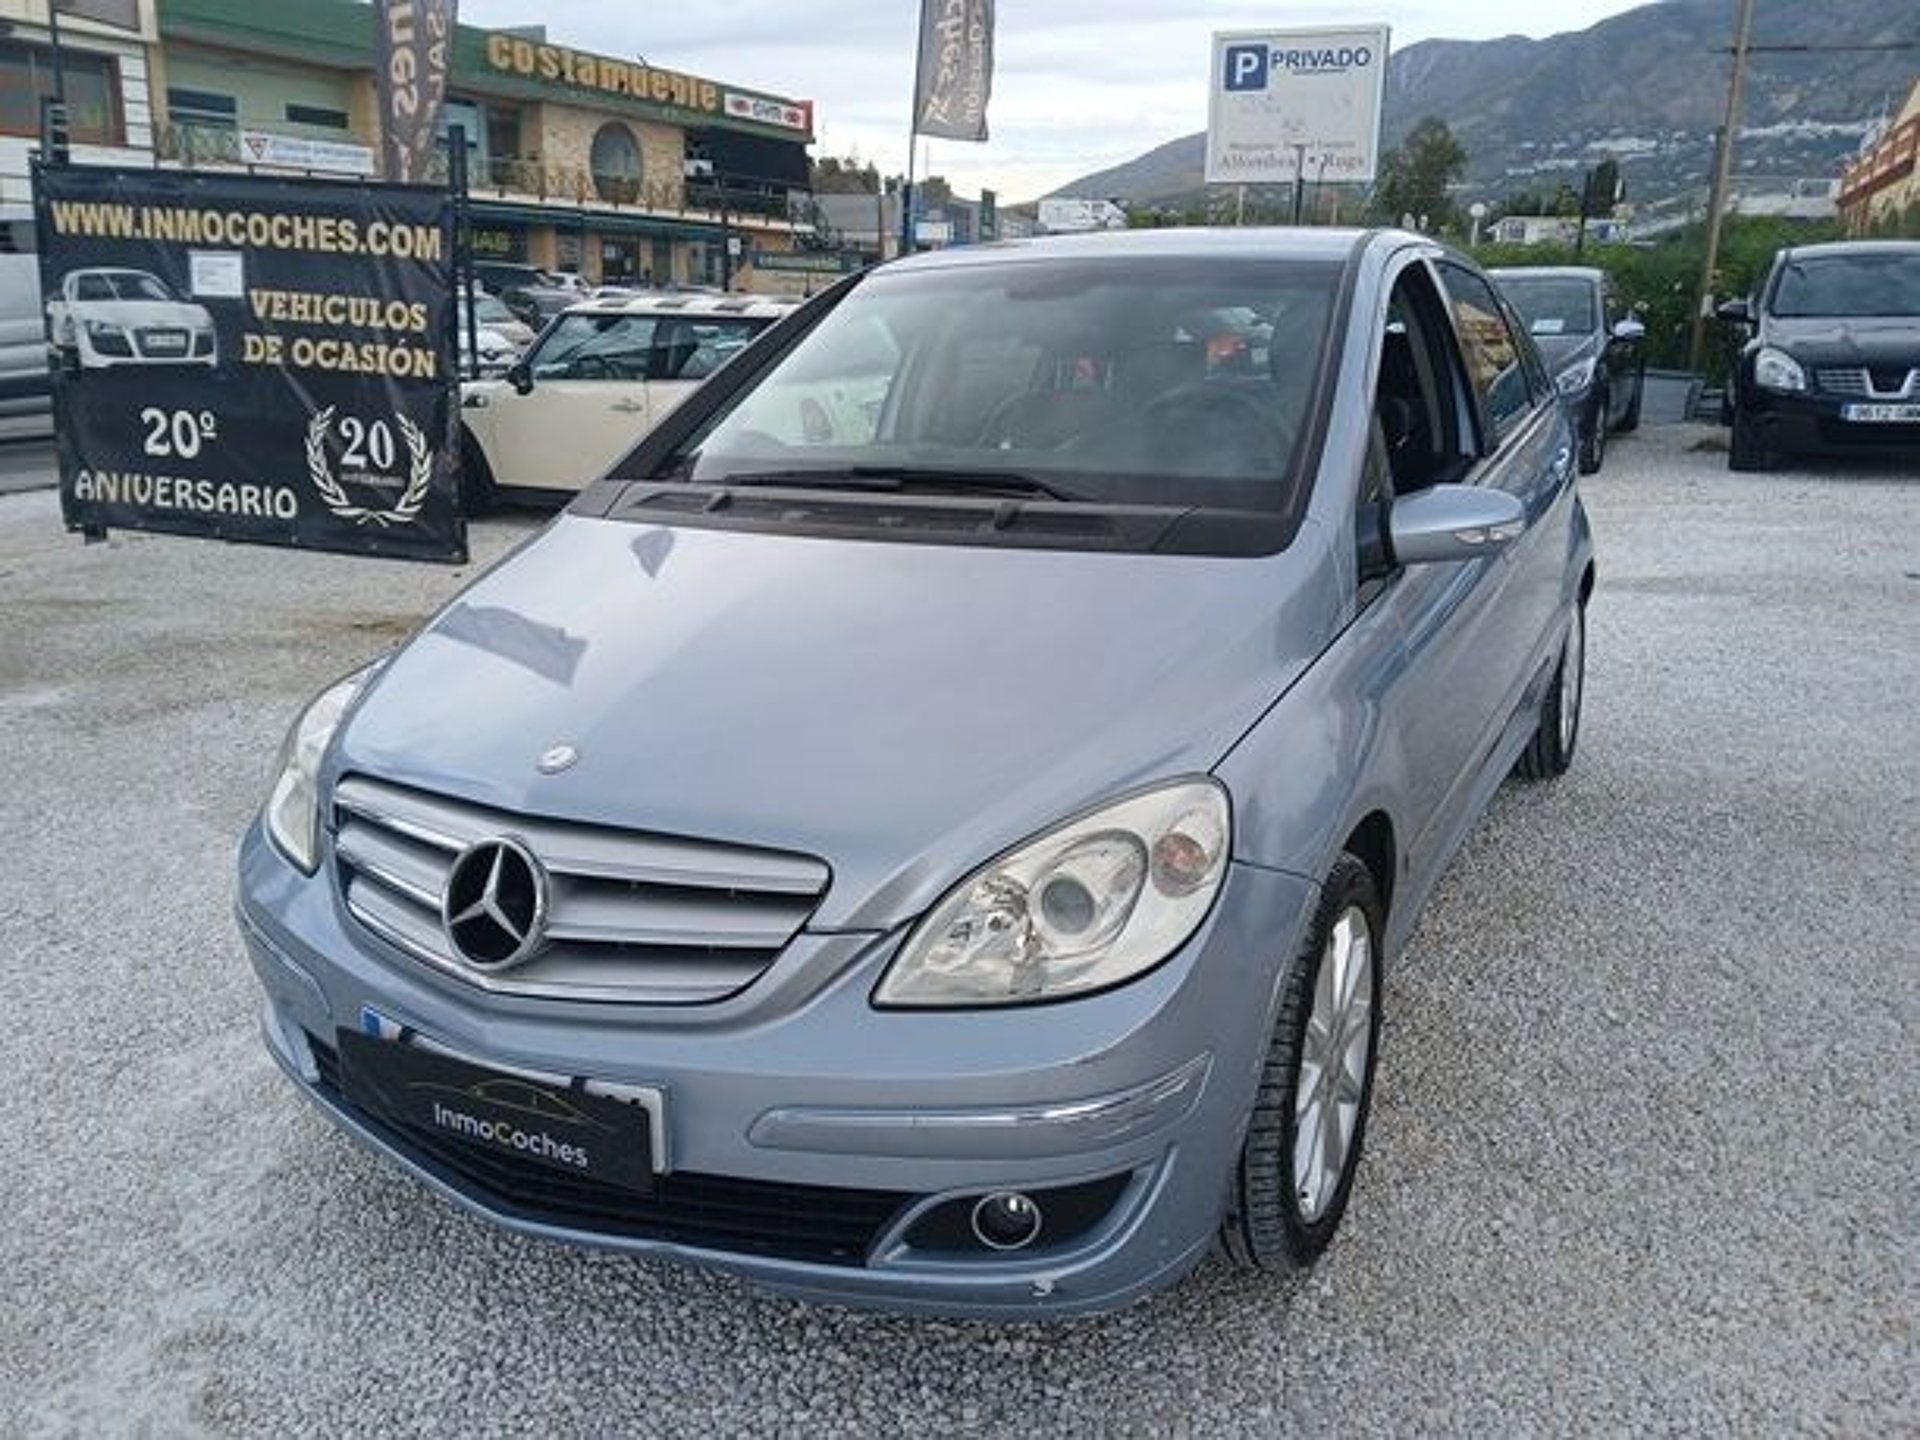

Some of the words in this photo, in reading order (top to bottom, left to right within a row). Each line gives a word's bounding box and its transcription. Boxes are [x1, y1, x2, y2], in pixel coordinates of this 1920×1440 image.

[1235, 52, 1259, 84] P
[1271, 47, 1371, 68] PRIVADO
[51, 202, 441, 260] WWW.INMOCOCHES.COM
[250, 289, 427, 332] VEHICULOS
[244, 334, 284, 364] DE
[292, 338, 435, 379] OCASIÓN
[340, 416, 394, 469] 20
[74, 469, 297, 518] ANIVERSARIO
[434, 1103, 588, 1168] InmoCoches
